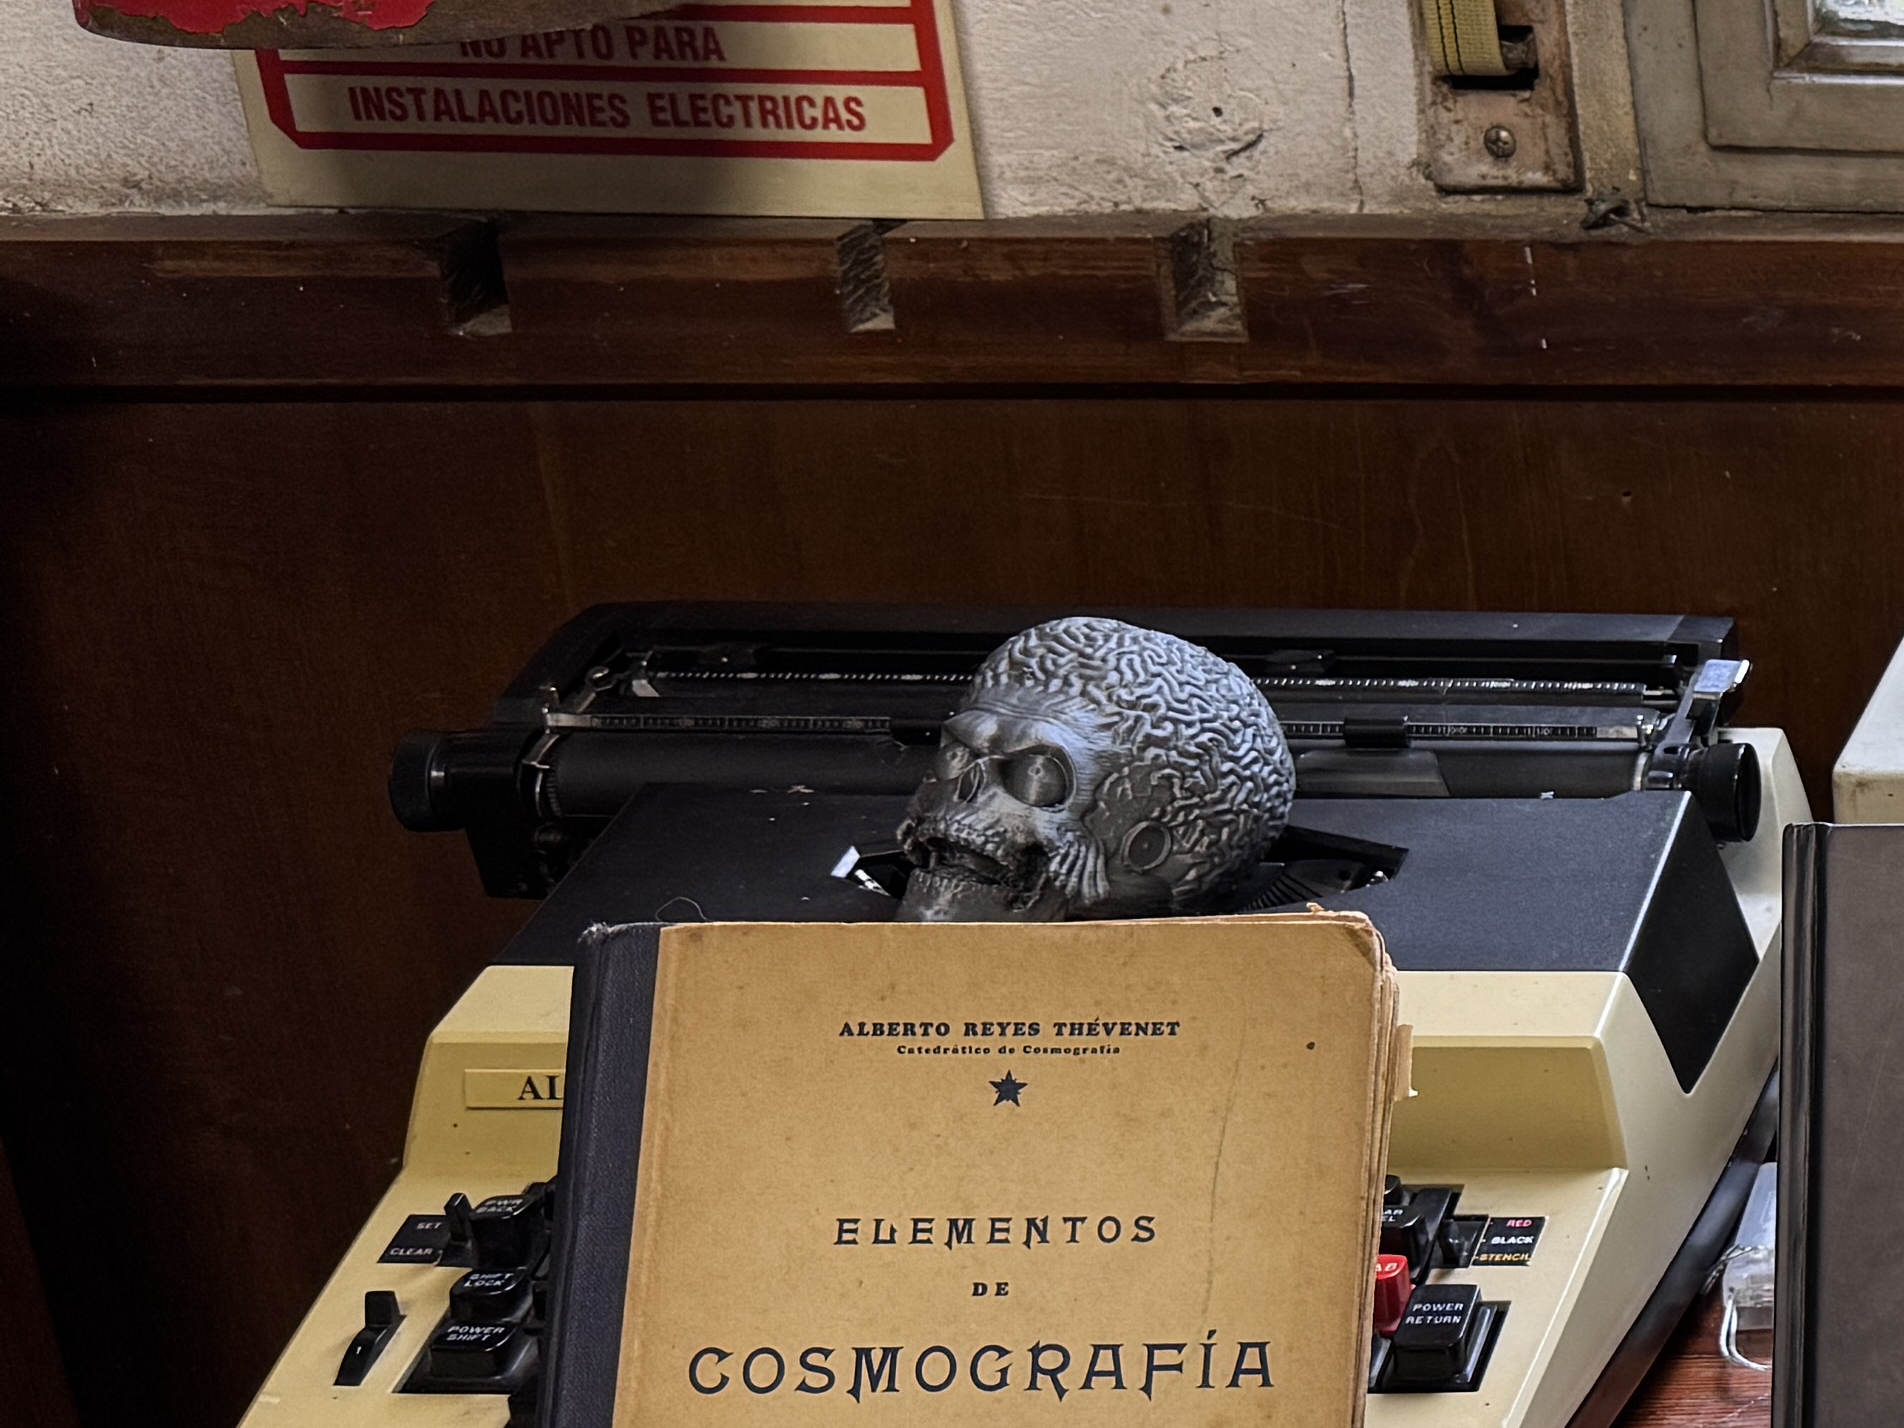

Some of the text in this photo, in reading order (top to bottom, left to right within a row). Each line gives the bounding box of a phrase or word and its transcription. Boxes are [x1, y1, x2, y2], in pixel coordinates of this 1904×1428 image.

[520, 24, 615, 62] APTO
[626, 23, 727, 63] PARA
[348, 84, 868, 133] INSTALACIONES ELECTRICAS
[839, 1017, 1181, 1037] ALBERTO REYES THÉVENET
[896, 1044, 1121, 1057] Catedrático de Cosmografía
[1382, 1208, 1403, 1216] AR
[417, 1221, 442, 1230] SET
[1506, 1219, 1532, 1228] RED
[833, 1215, 1157, 1251] ELEMENTOS
[1491, 1235, 1534, 1245] BLACK
[389, 1247, 433, 1256] CLEAR
[1374, 1262, 1399, 1272] AB
[463, 1279, 505, 1287] LOCK
[971, 1281, 1010, 1297] DE
[1412, 1303, 1464, 1312] POWER
[1405, 1315, 1461, 1324] RETURN
[446, 1325, 505, 1334] POWER
[446, 1333, 492, 1342] SHIFT
[688, 1329, 1275, 1404] COSMOGRAFÍA
